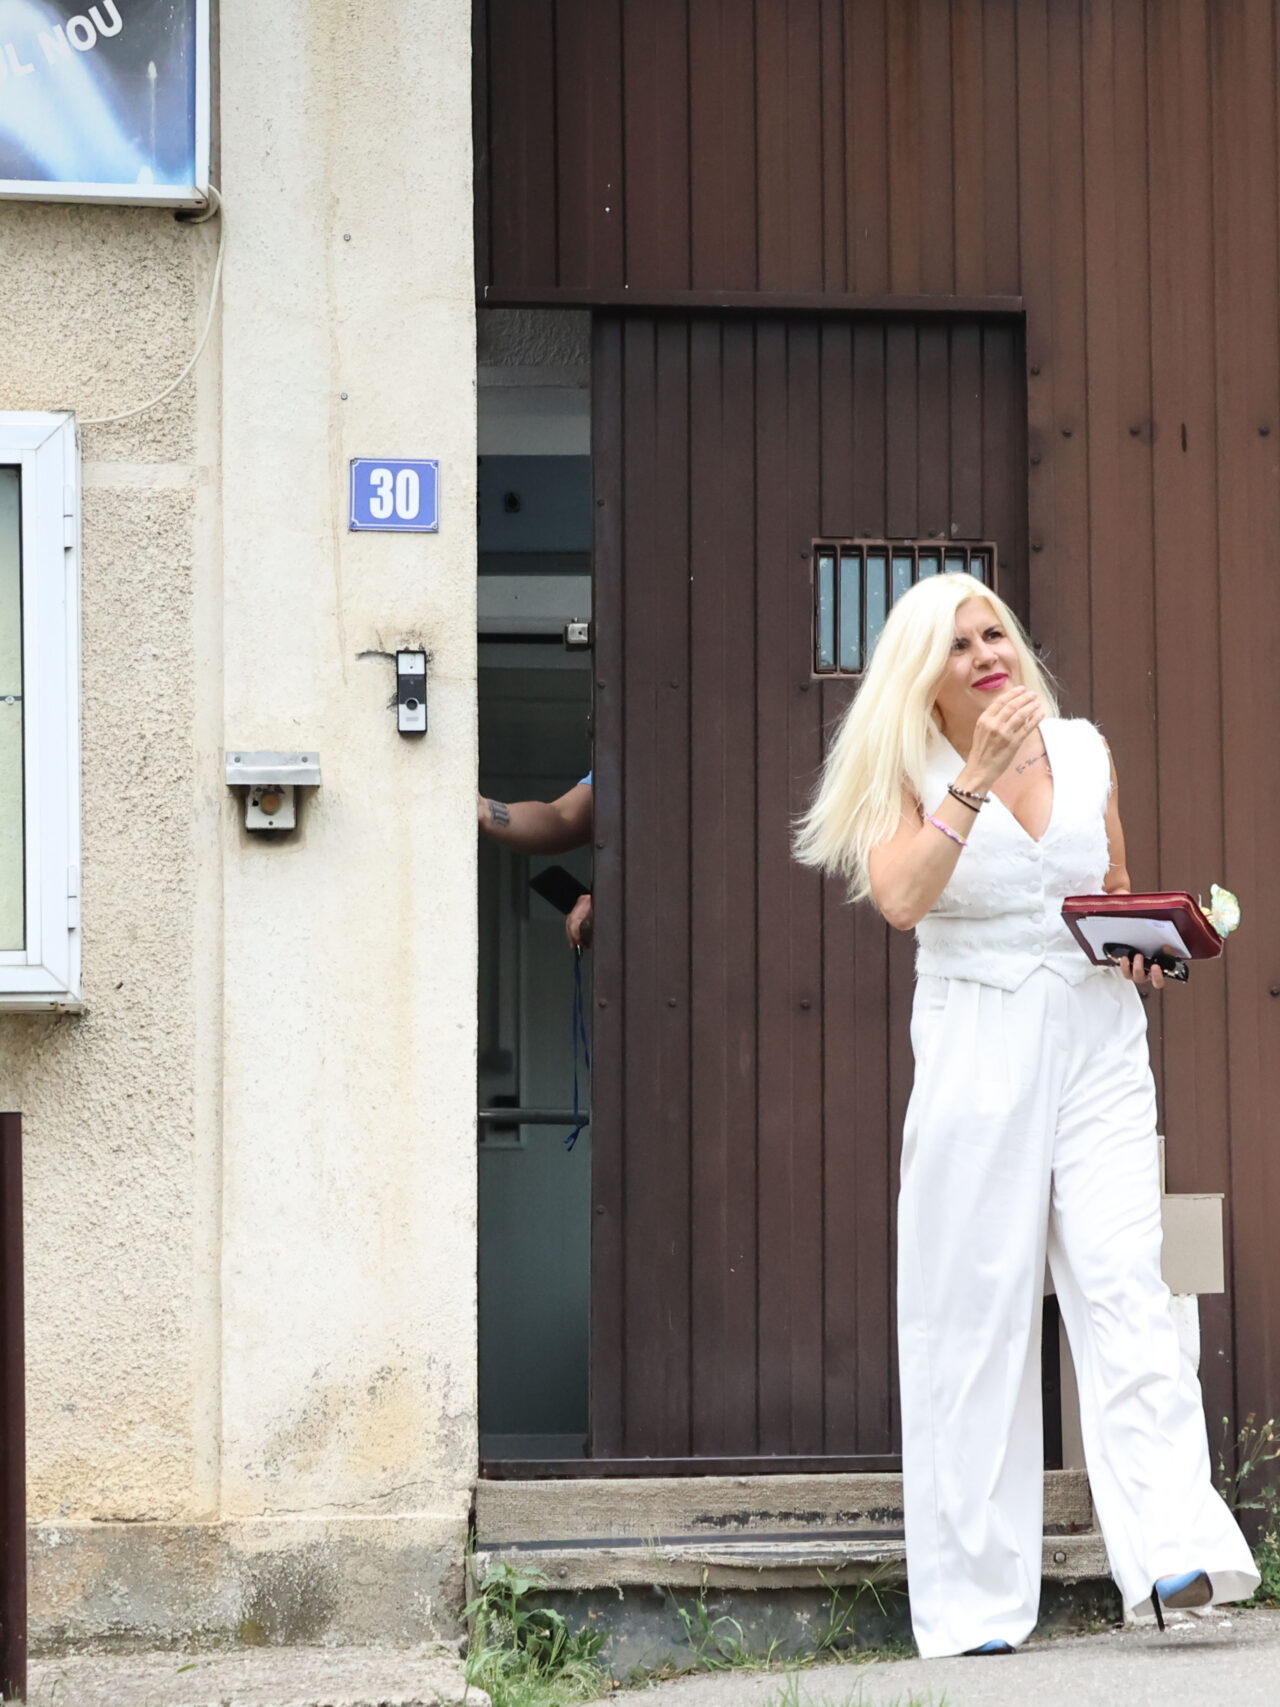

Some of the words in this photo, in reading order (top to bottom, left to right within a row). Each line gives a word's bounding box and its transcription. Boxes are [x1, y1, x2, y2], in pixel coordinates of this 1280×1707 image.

[0, 42, 36, 78] L
[37, 0, 123, 65] NOU
[369, 467, 420, 520] 30
